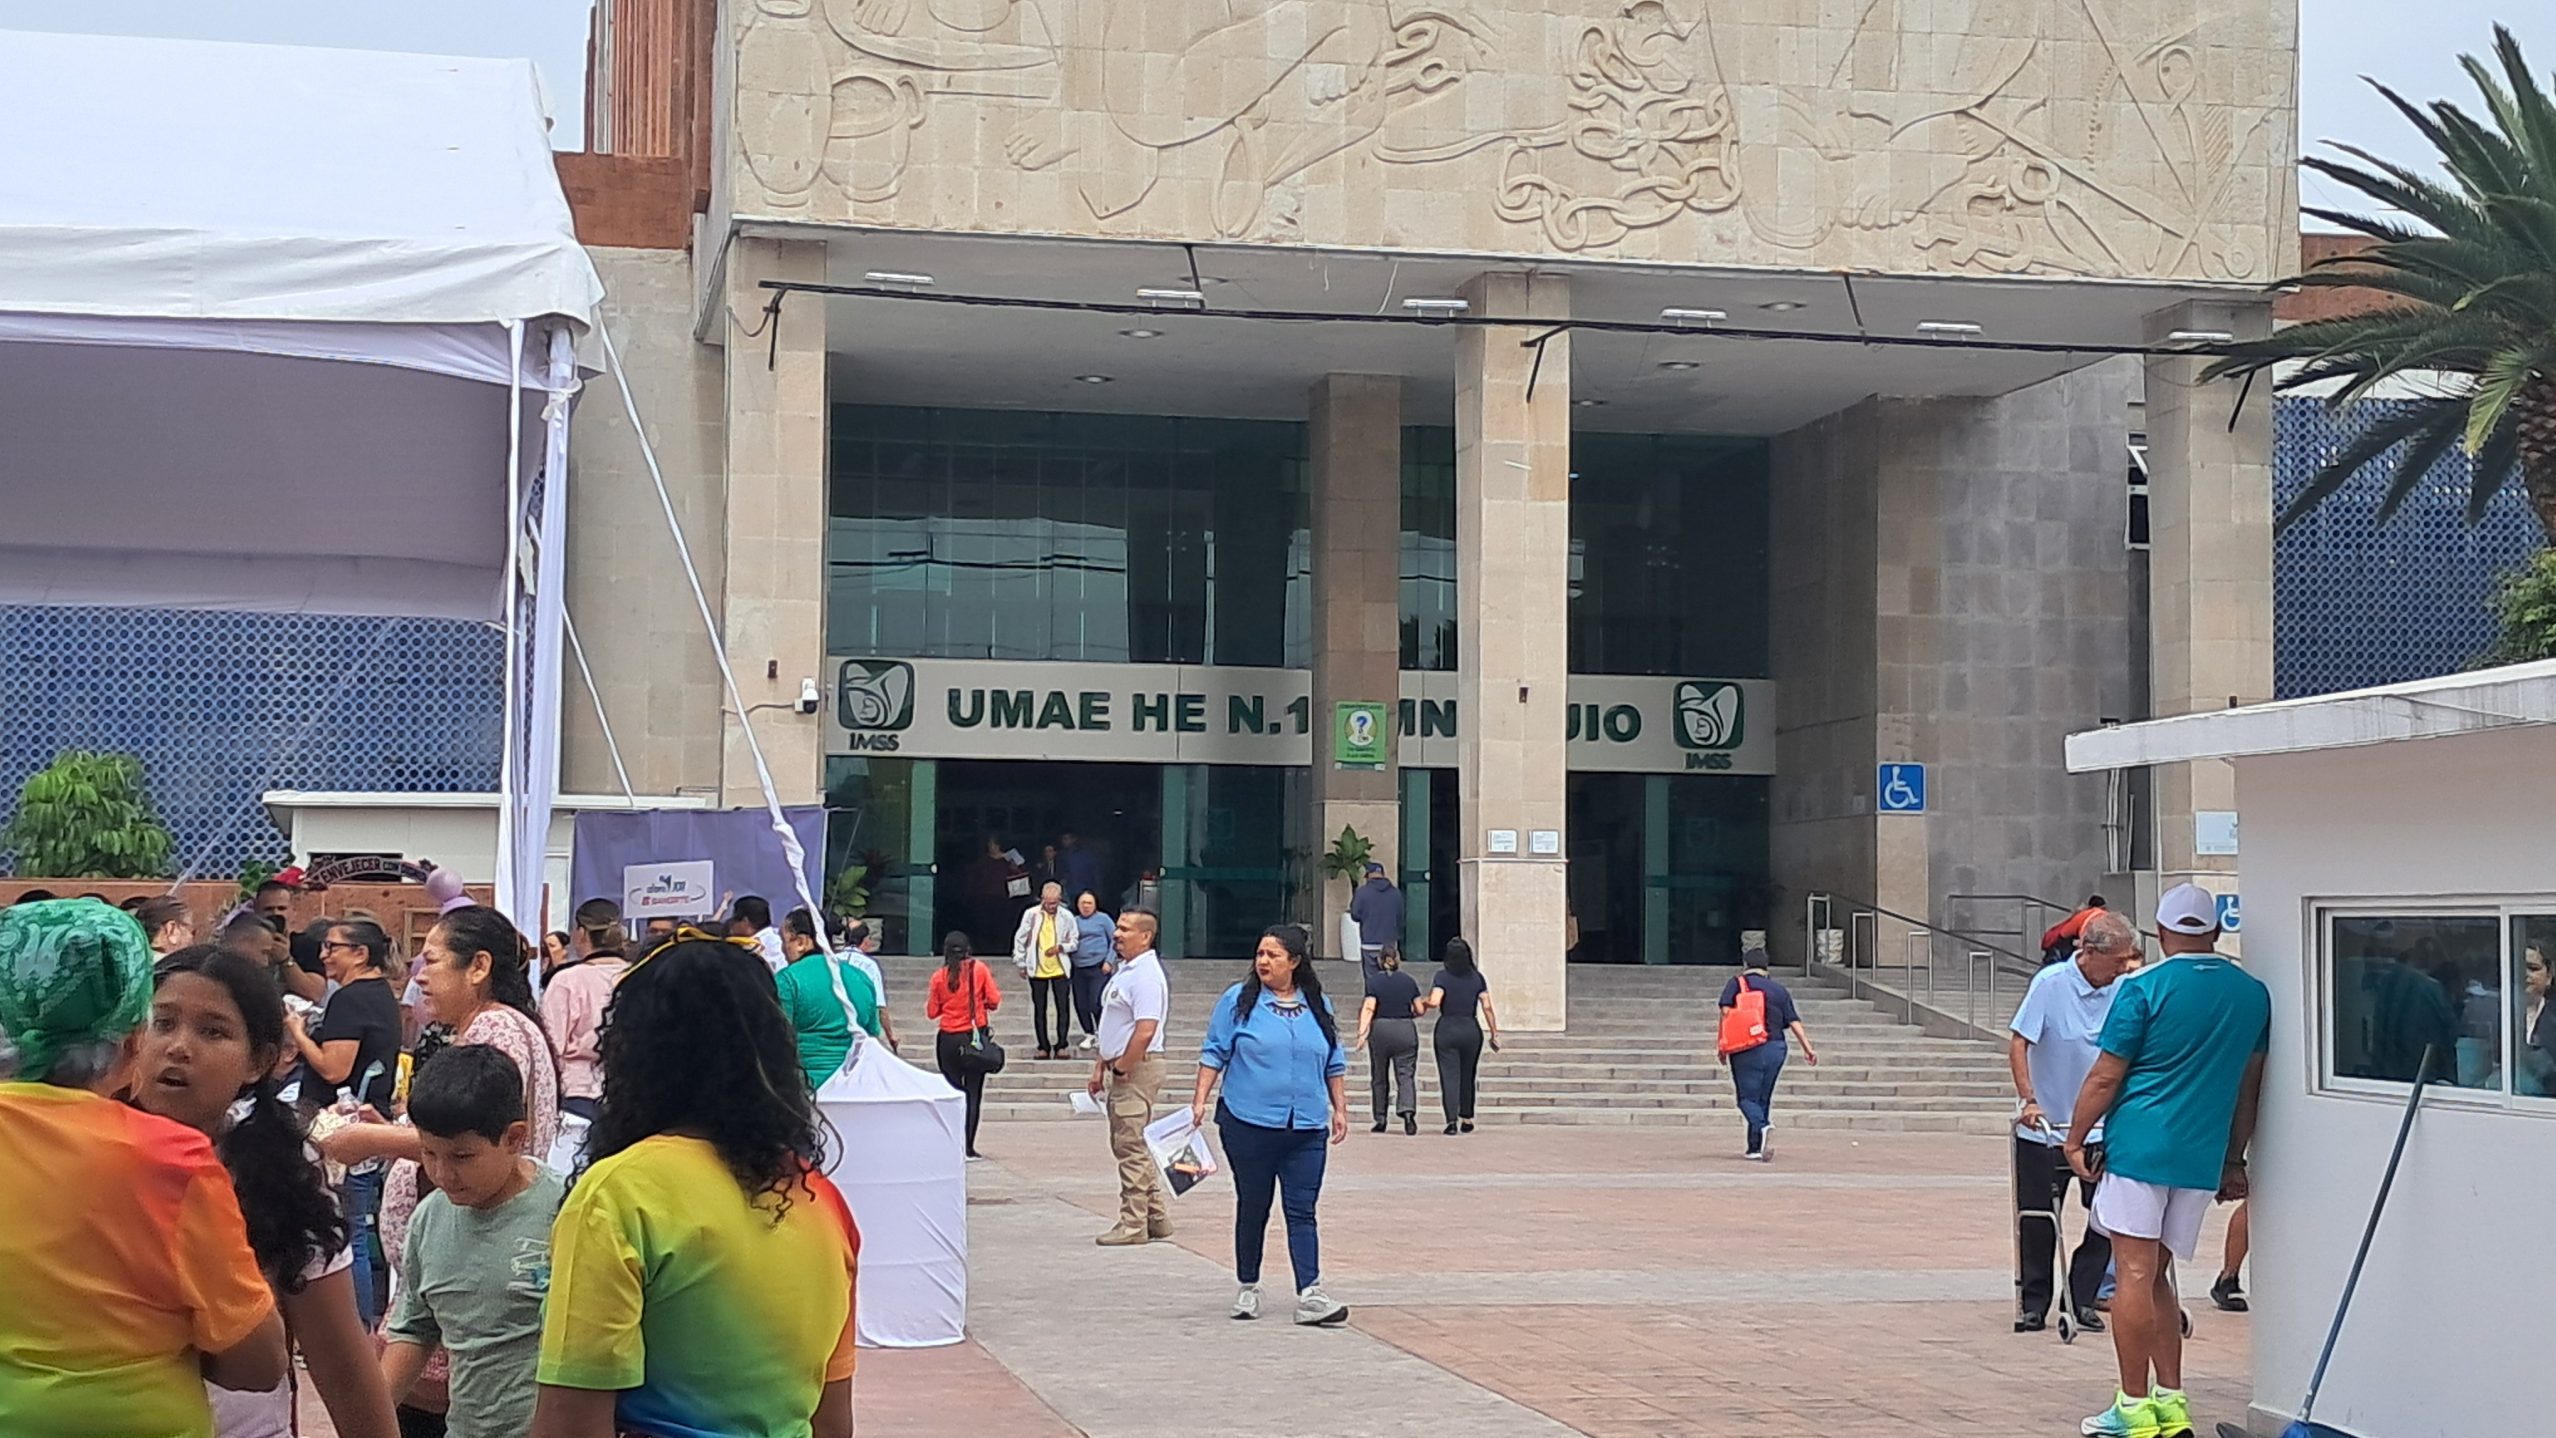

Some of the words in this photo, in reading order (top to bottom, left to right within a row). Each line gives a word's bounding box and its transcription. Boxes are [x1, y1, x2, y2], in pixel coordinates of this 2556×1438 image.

[948, 687, 1111, 730] UMAE
[1132, 693, 1206, 732] HE
[1228, 695, 1309, 734] N.1
[849, 732, 900, 751] IMSS
[1685, 752, 1733, 770] IMSS
[320, 858, 380, 884] ENVEJECER
